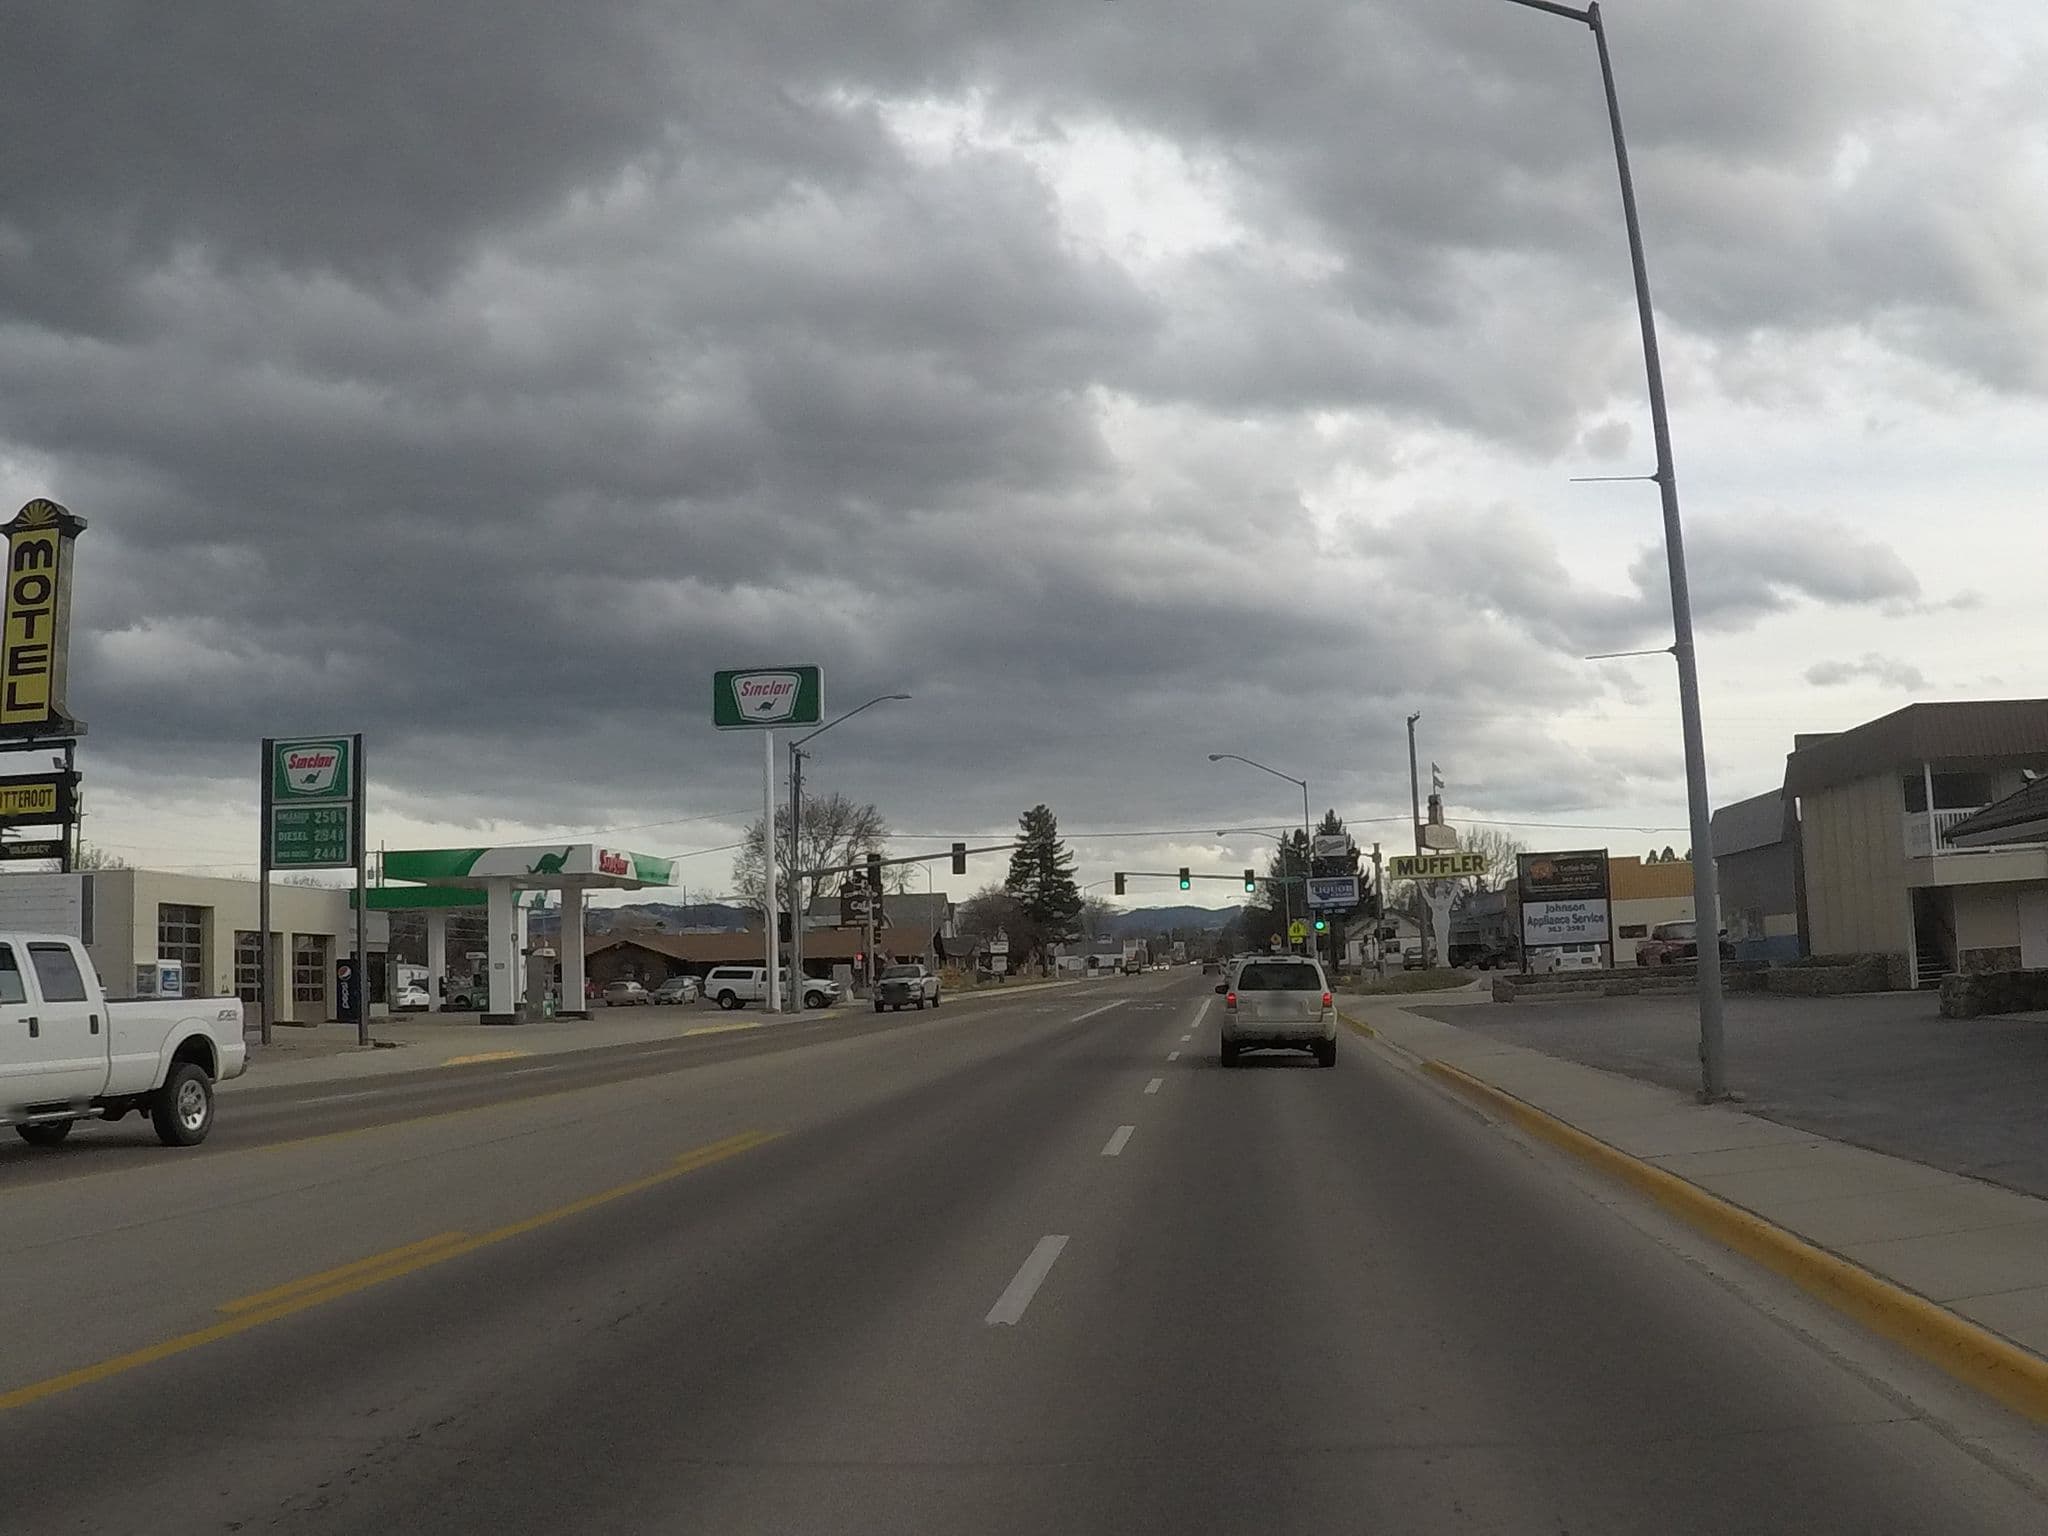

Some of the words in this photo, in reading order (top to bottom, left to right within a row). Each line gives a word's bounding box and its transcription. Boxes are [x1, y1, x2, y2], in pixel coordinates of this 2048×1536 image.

[6, 538, 54, 712] MOTEL
[741, 680, 793, 697] Sinclair
[288, 752, 335, 769] Sinclair
[278, 831, 309, 842] DIESEL
[1397, 855, 1484, 876] MUFFLER
[1545, 903, 1586, 914] Johnson
[1527, 915, 1571, 929] Appliance
[1572, 912, 1604, 924] Service
